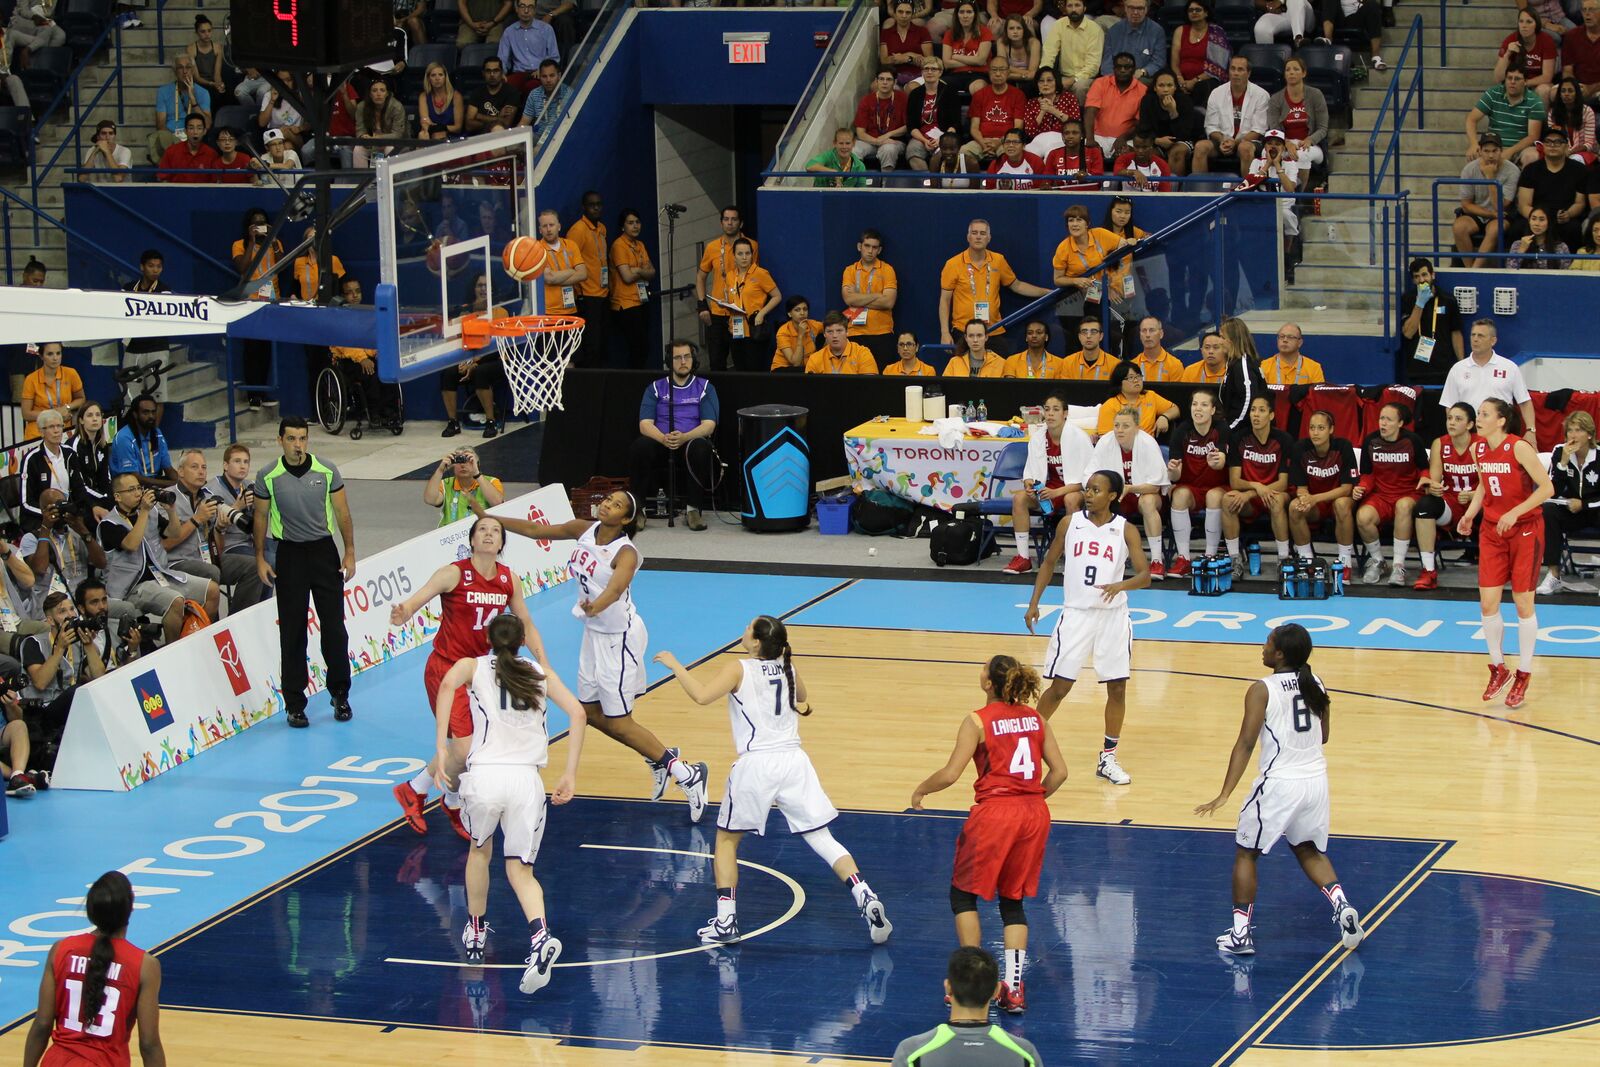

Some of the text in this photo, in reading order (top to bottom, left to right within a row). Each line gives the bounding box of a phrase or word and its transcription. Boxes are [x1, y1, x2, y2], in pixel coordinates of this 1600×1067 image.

[733, 43, 762, 63] EXIT
[125, 297, 209, 321] SPALDING
[1243, 449, 1277, 464] CANADA
[1372, 452, 1410, 463] CANADA
[1306, 463, 1340, 478] CANADA
[1451, 475, 1473, 492] 11
[1488, 475, 1502, 497] 8
[571, 549, 598, 577] USA
[1073, 541, 1114, 563] USA
[1084, 565, 1097, 587] 9
[466, 591, 508, 606] CANADA
[769, 678, 783, 716] 7
[992, 716, 1040, 736] LANGLOIS
[1009, 736, 1036, 780] 4
[63, 978, 121, 1037] 13
